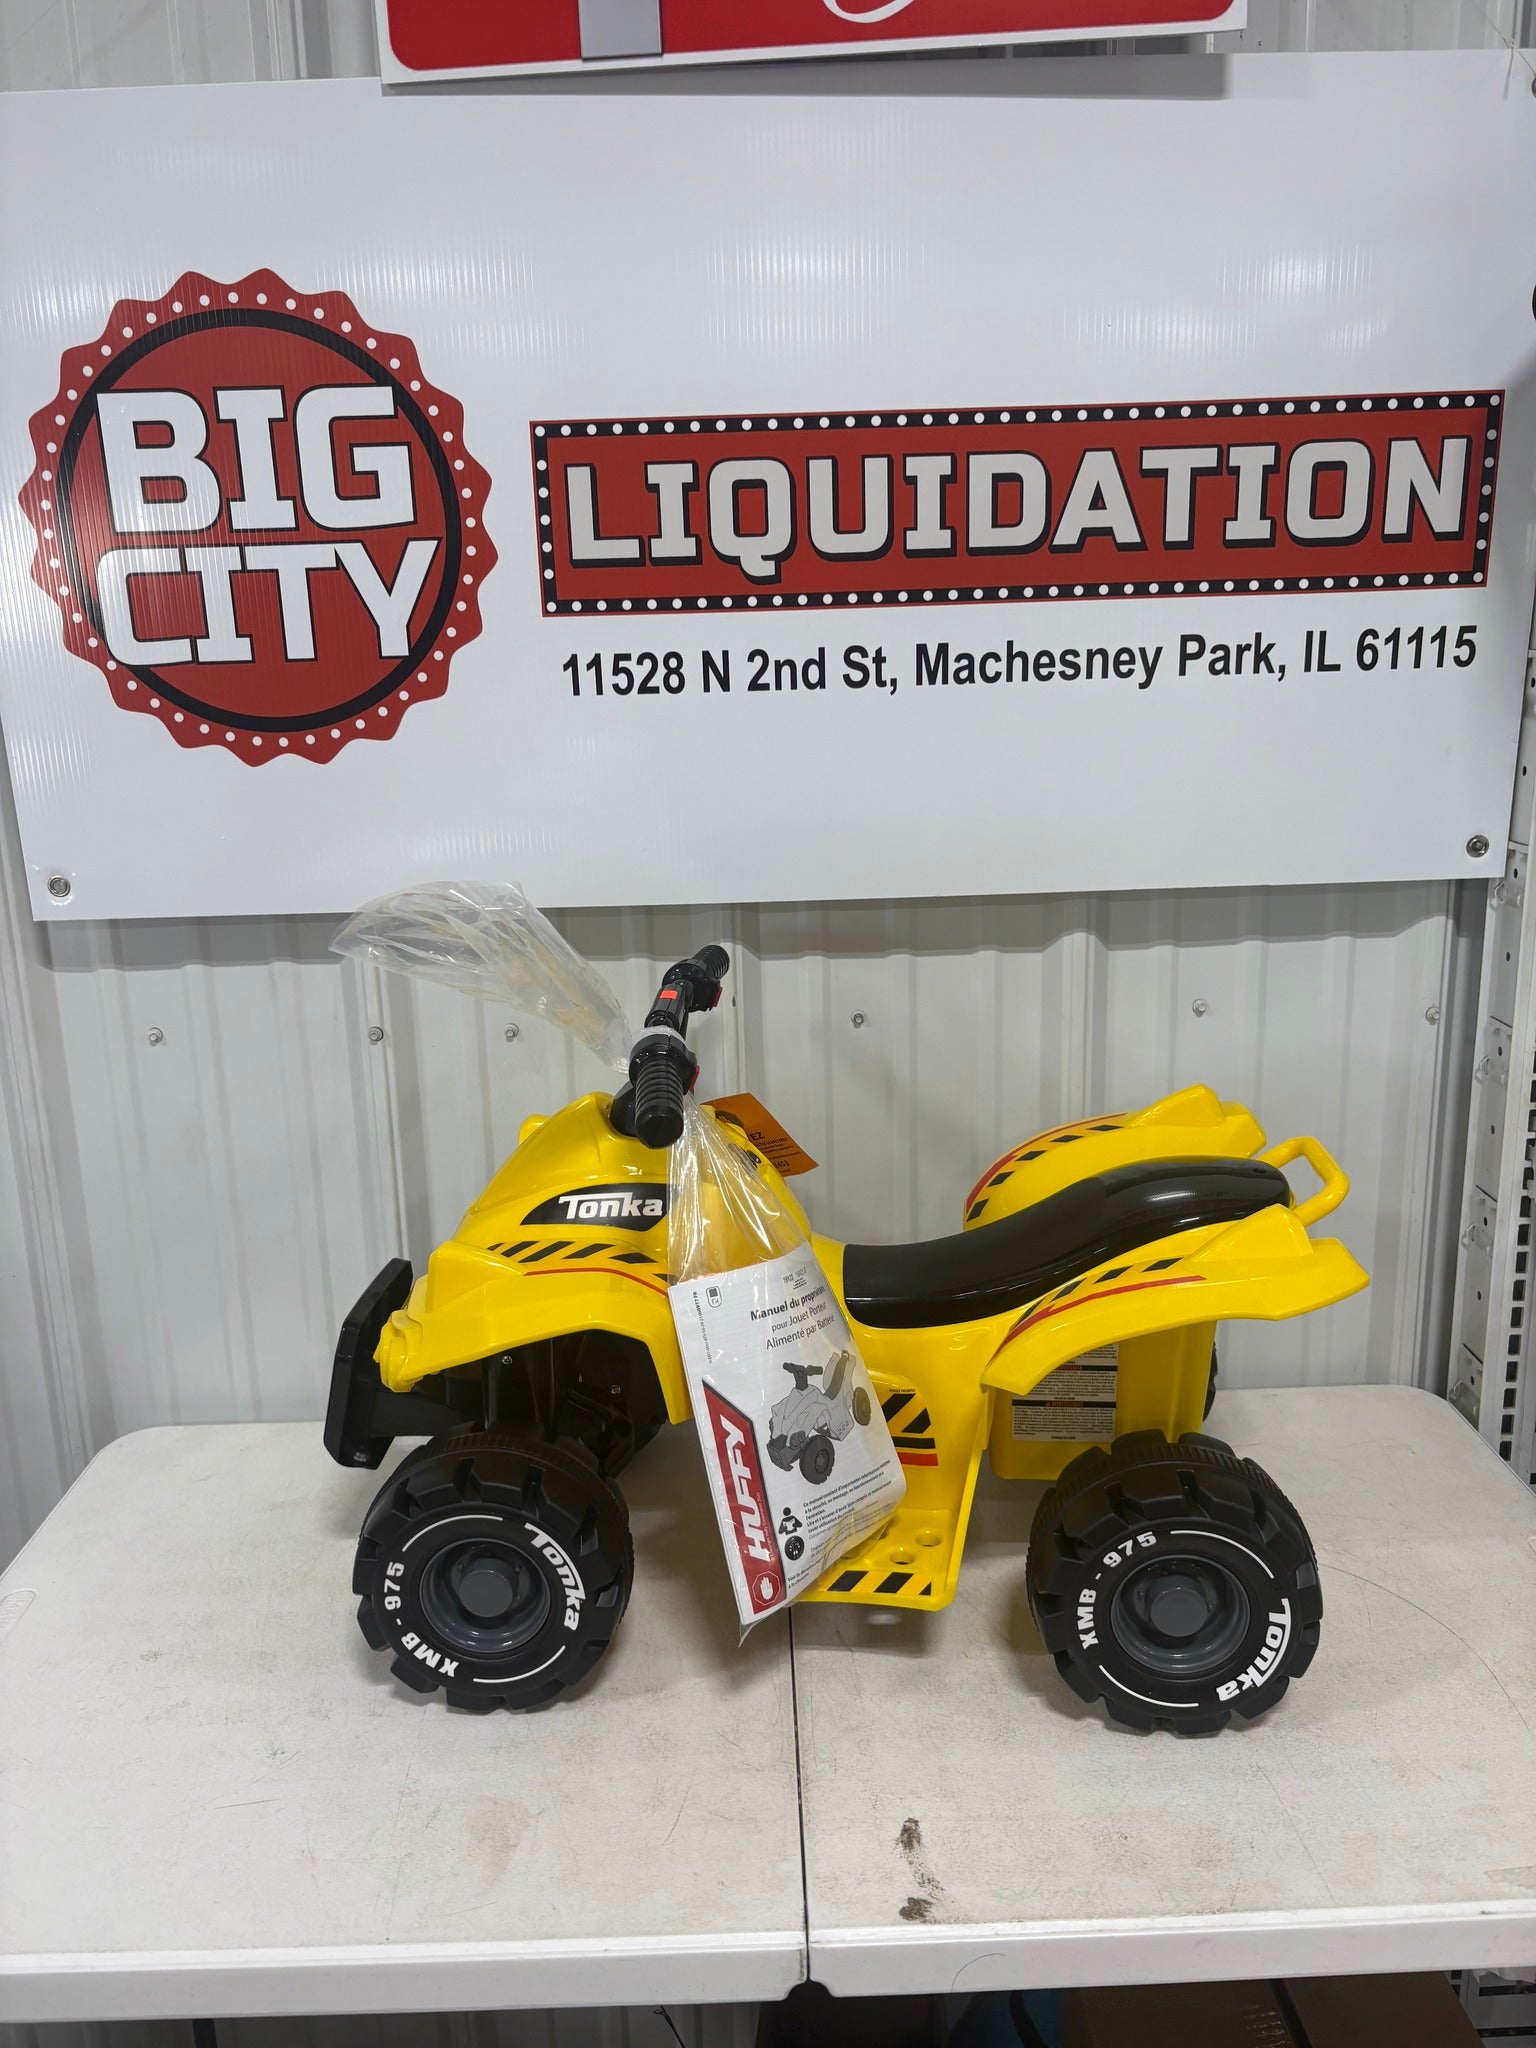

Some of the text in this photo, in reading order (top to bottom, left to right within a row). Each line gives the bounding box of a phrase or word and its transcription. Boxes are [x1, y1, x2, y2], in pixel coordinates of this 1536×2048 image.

[95, 385, 416, 533] BIG
[564, 434, 1472, 585] LIQUIDATION
[97, 540, 442, 667] CITY
[562, 625, 1478, 697] 11528 N 2nd St, Machesney Park, IL 61115
[558, 1192, 663, 1220] Tonka
[750, 1302, 788, 1321] Manuel
[789, 1298, 800, 1309] du
[766, 1328, 805, 1350] Alimenté
[806, 1324, 817, 1338] par
[772, 1302, 827, 1333] pour Jouet Porteur
[720, 1414, 771, 1562] HUFFY
[384, 1561, 405, 1611] 975
[524, 1522, 587, 1632] Tonka
[1076, 1588, 1098, 1650] XMB
[1103, 1531, 1157, 1568] 975
[401, 1631, 460, 1678] XMB
[1216, 1597, 1292, 1702] Tonka
